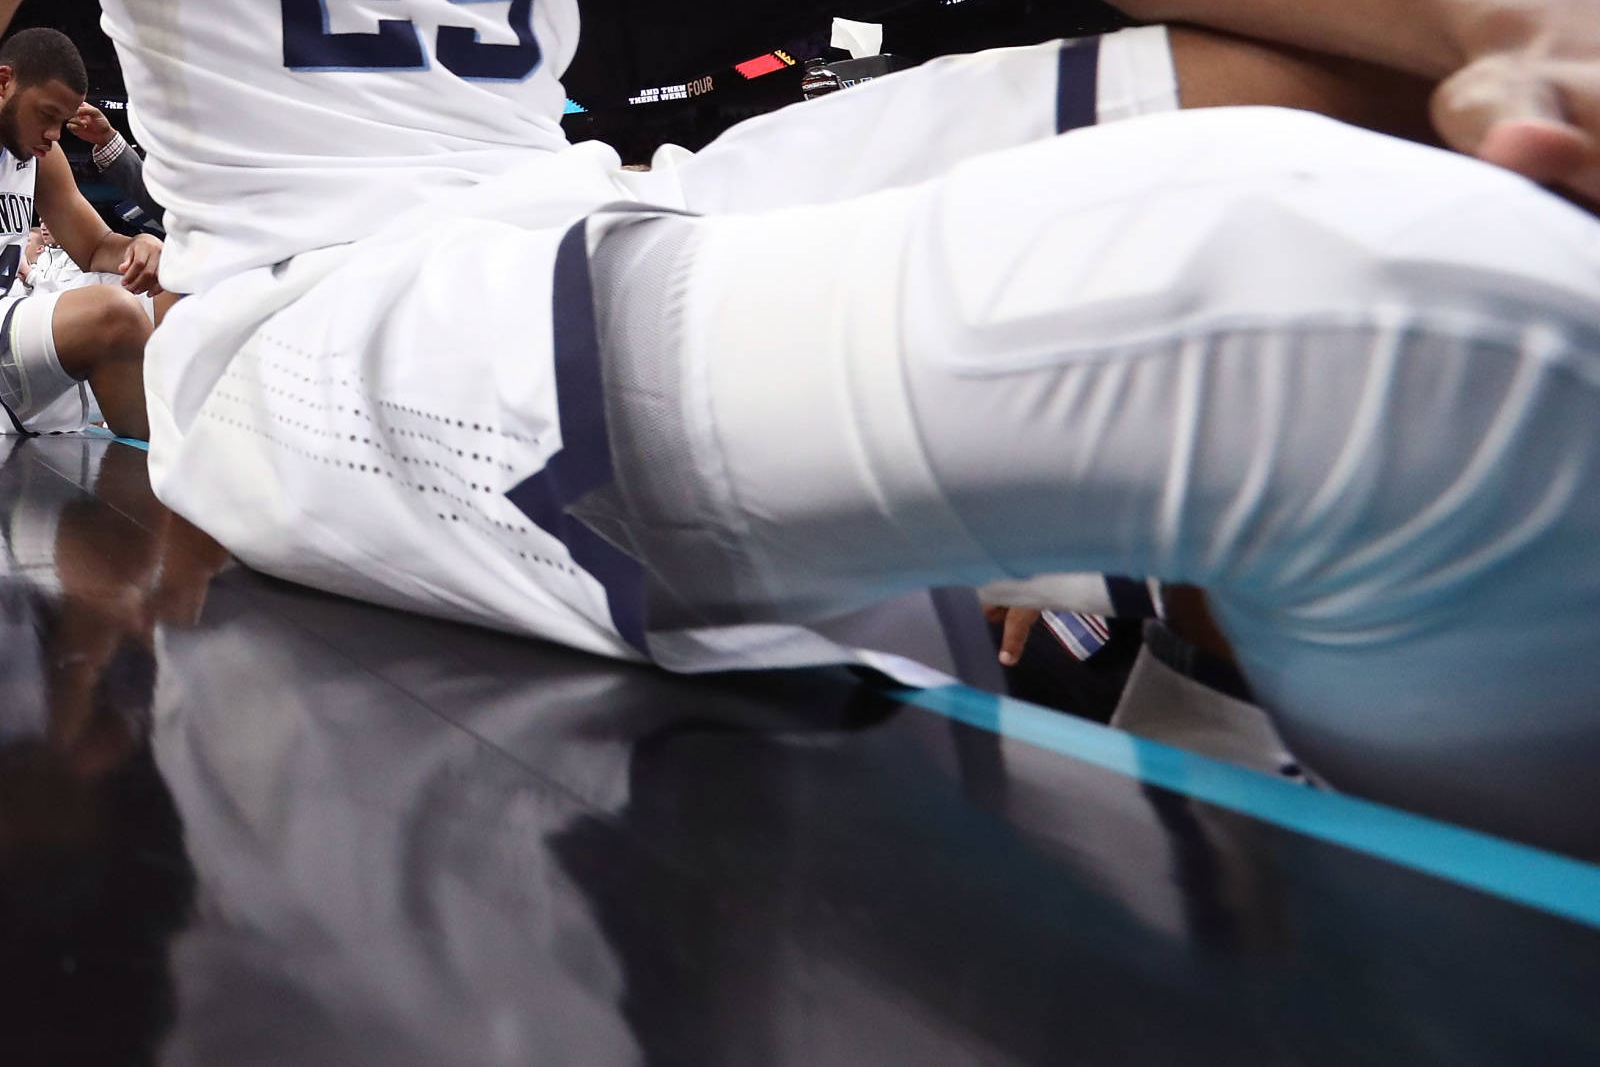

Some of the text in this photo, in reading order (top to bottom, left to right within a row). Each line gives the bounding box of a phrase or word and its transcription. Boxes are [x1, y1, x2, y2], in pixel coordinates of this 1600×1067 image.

[628, 76, 714, 105] THERE WERE FOUR
[640, 84, 686, 97] AND THEN
